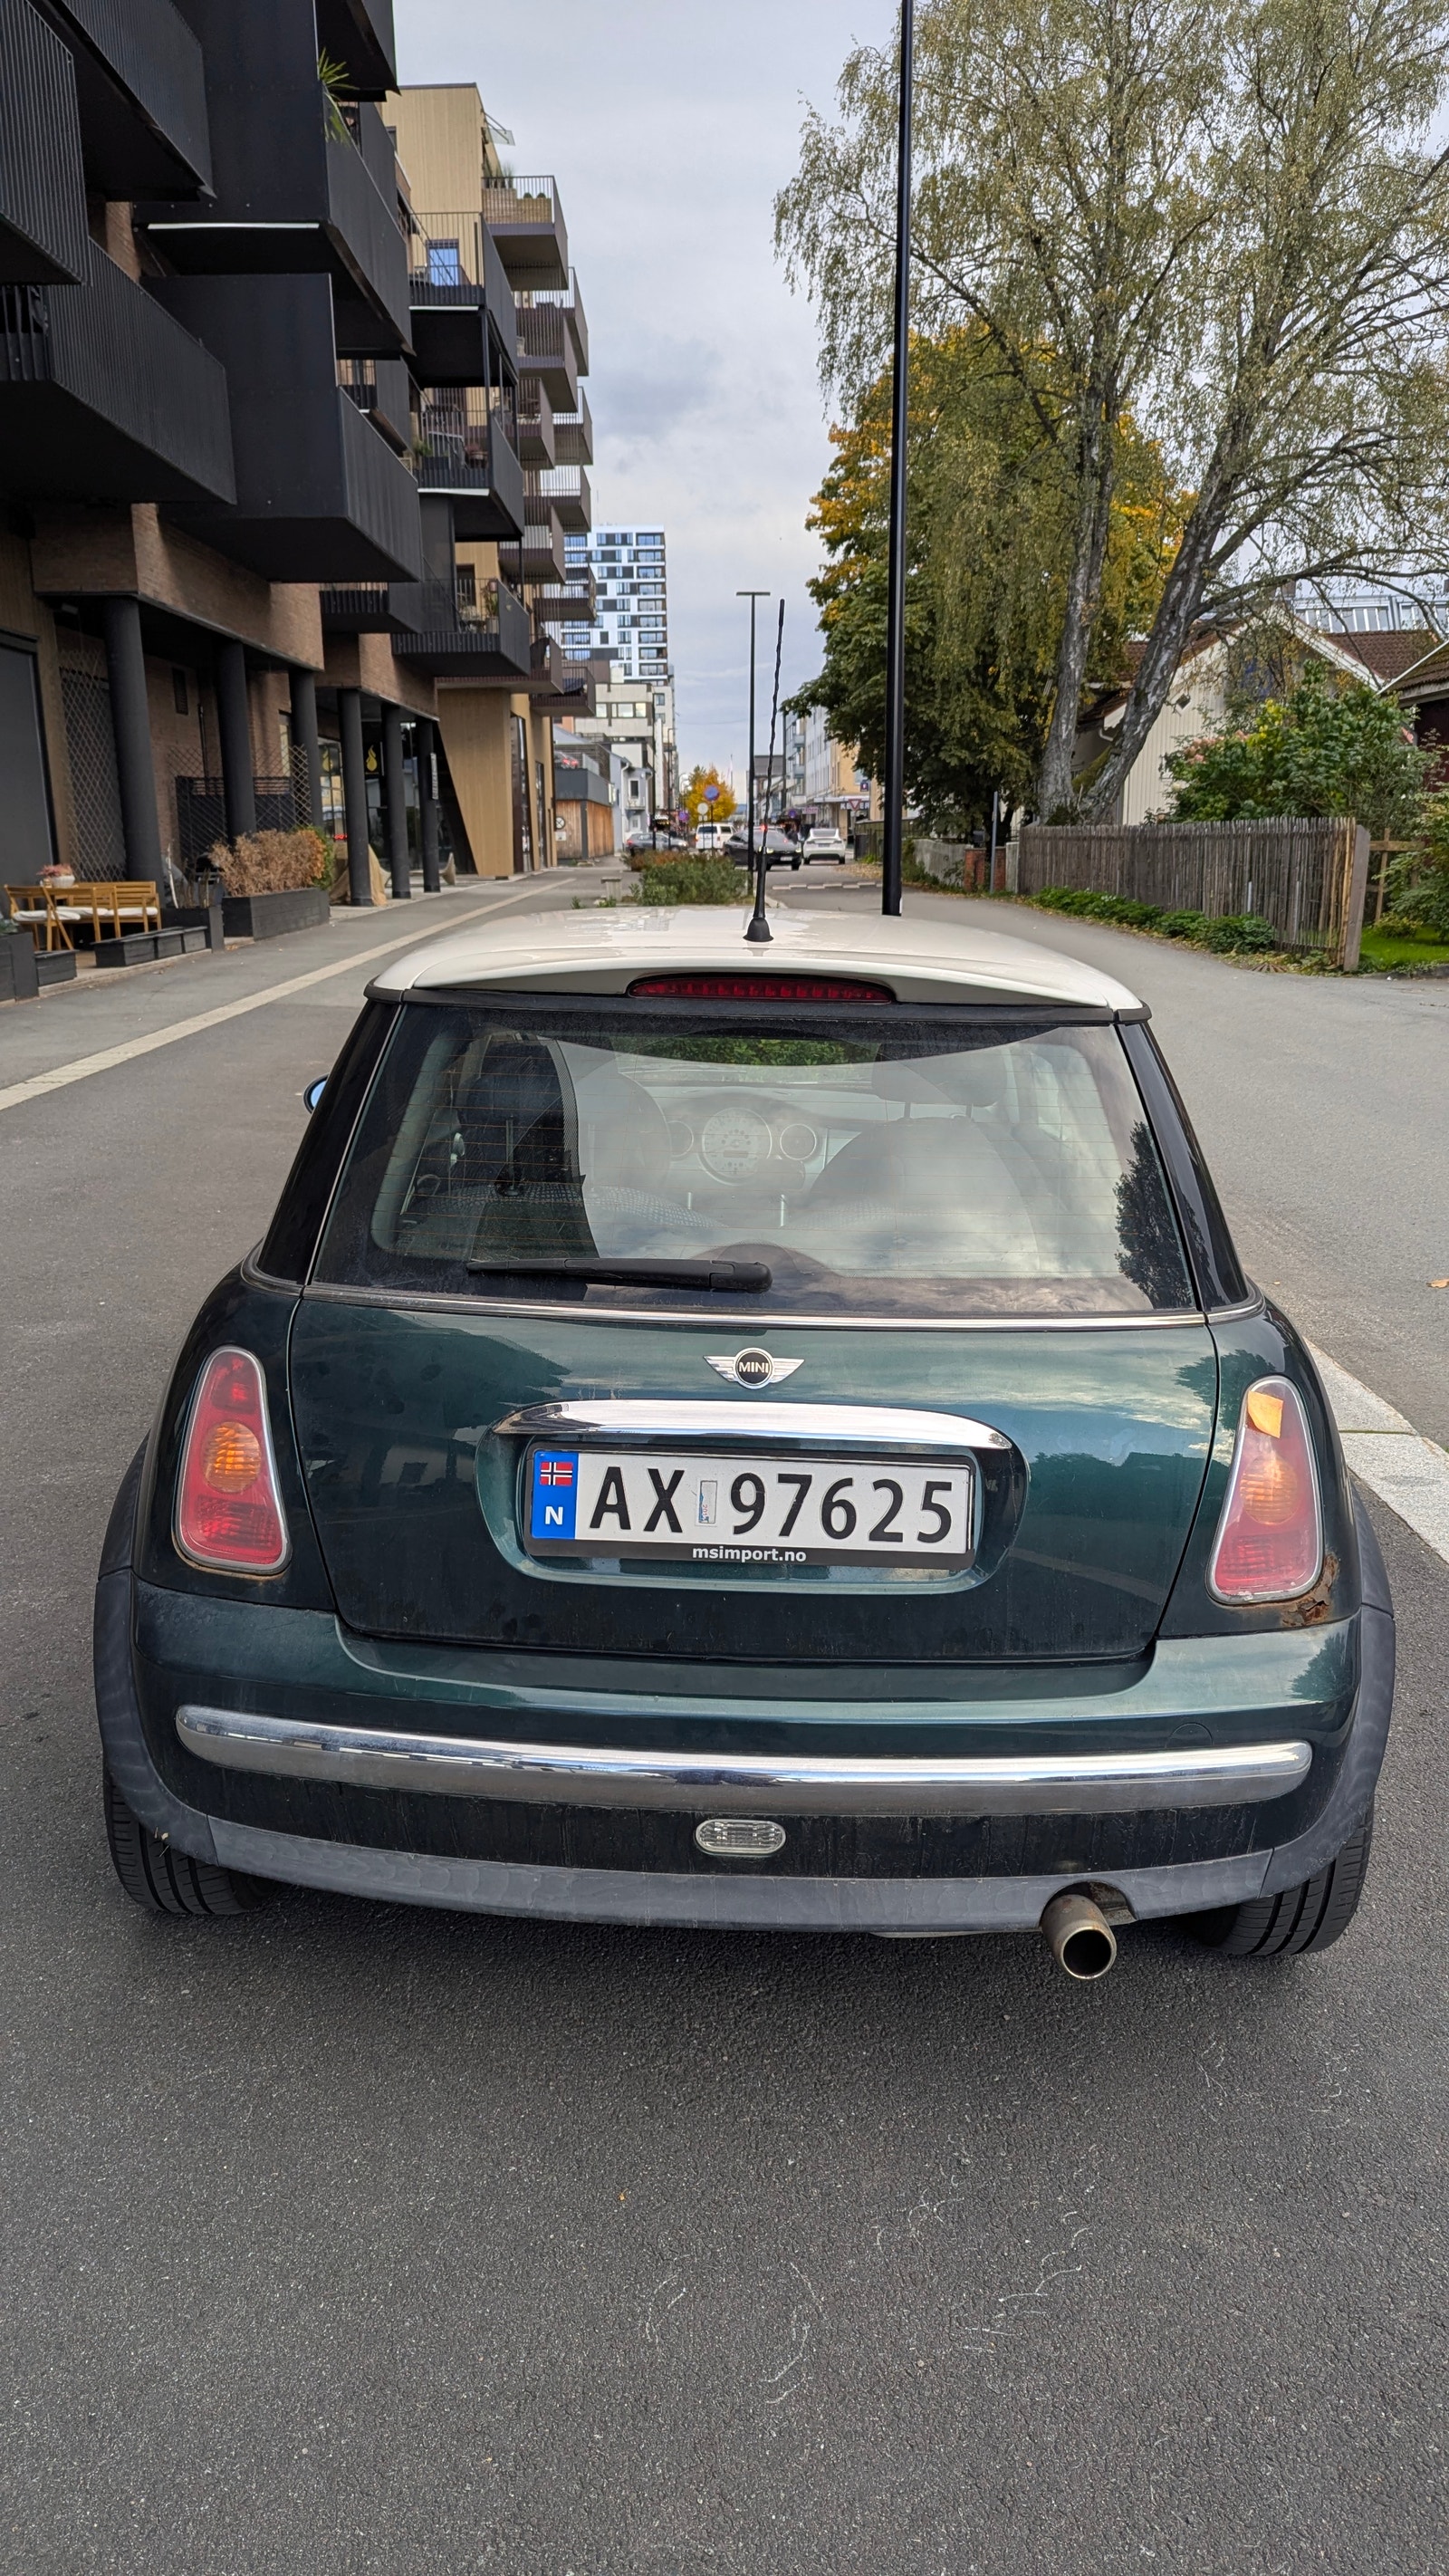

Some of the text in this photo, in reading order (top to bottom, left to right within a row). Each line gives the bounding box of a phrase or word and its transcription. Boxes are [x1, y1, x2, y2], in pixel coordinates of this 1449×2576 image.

[739, 1362, 769, 1373] MINI
[590, 1466, 953, 1543] AX 97625
[545, 1506, 563, 1525] N
[692, 1545, 806, 1562] msimport.no
